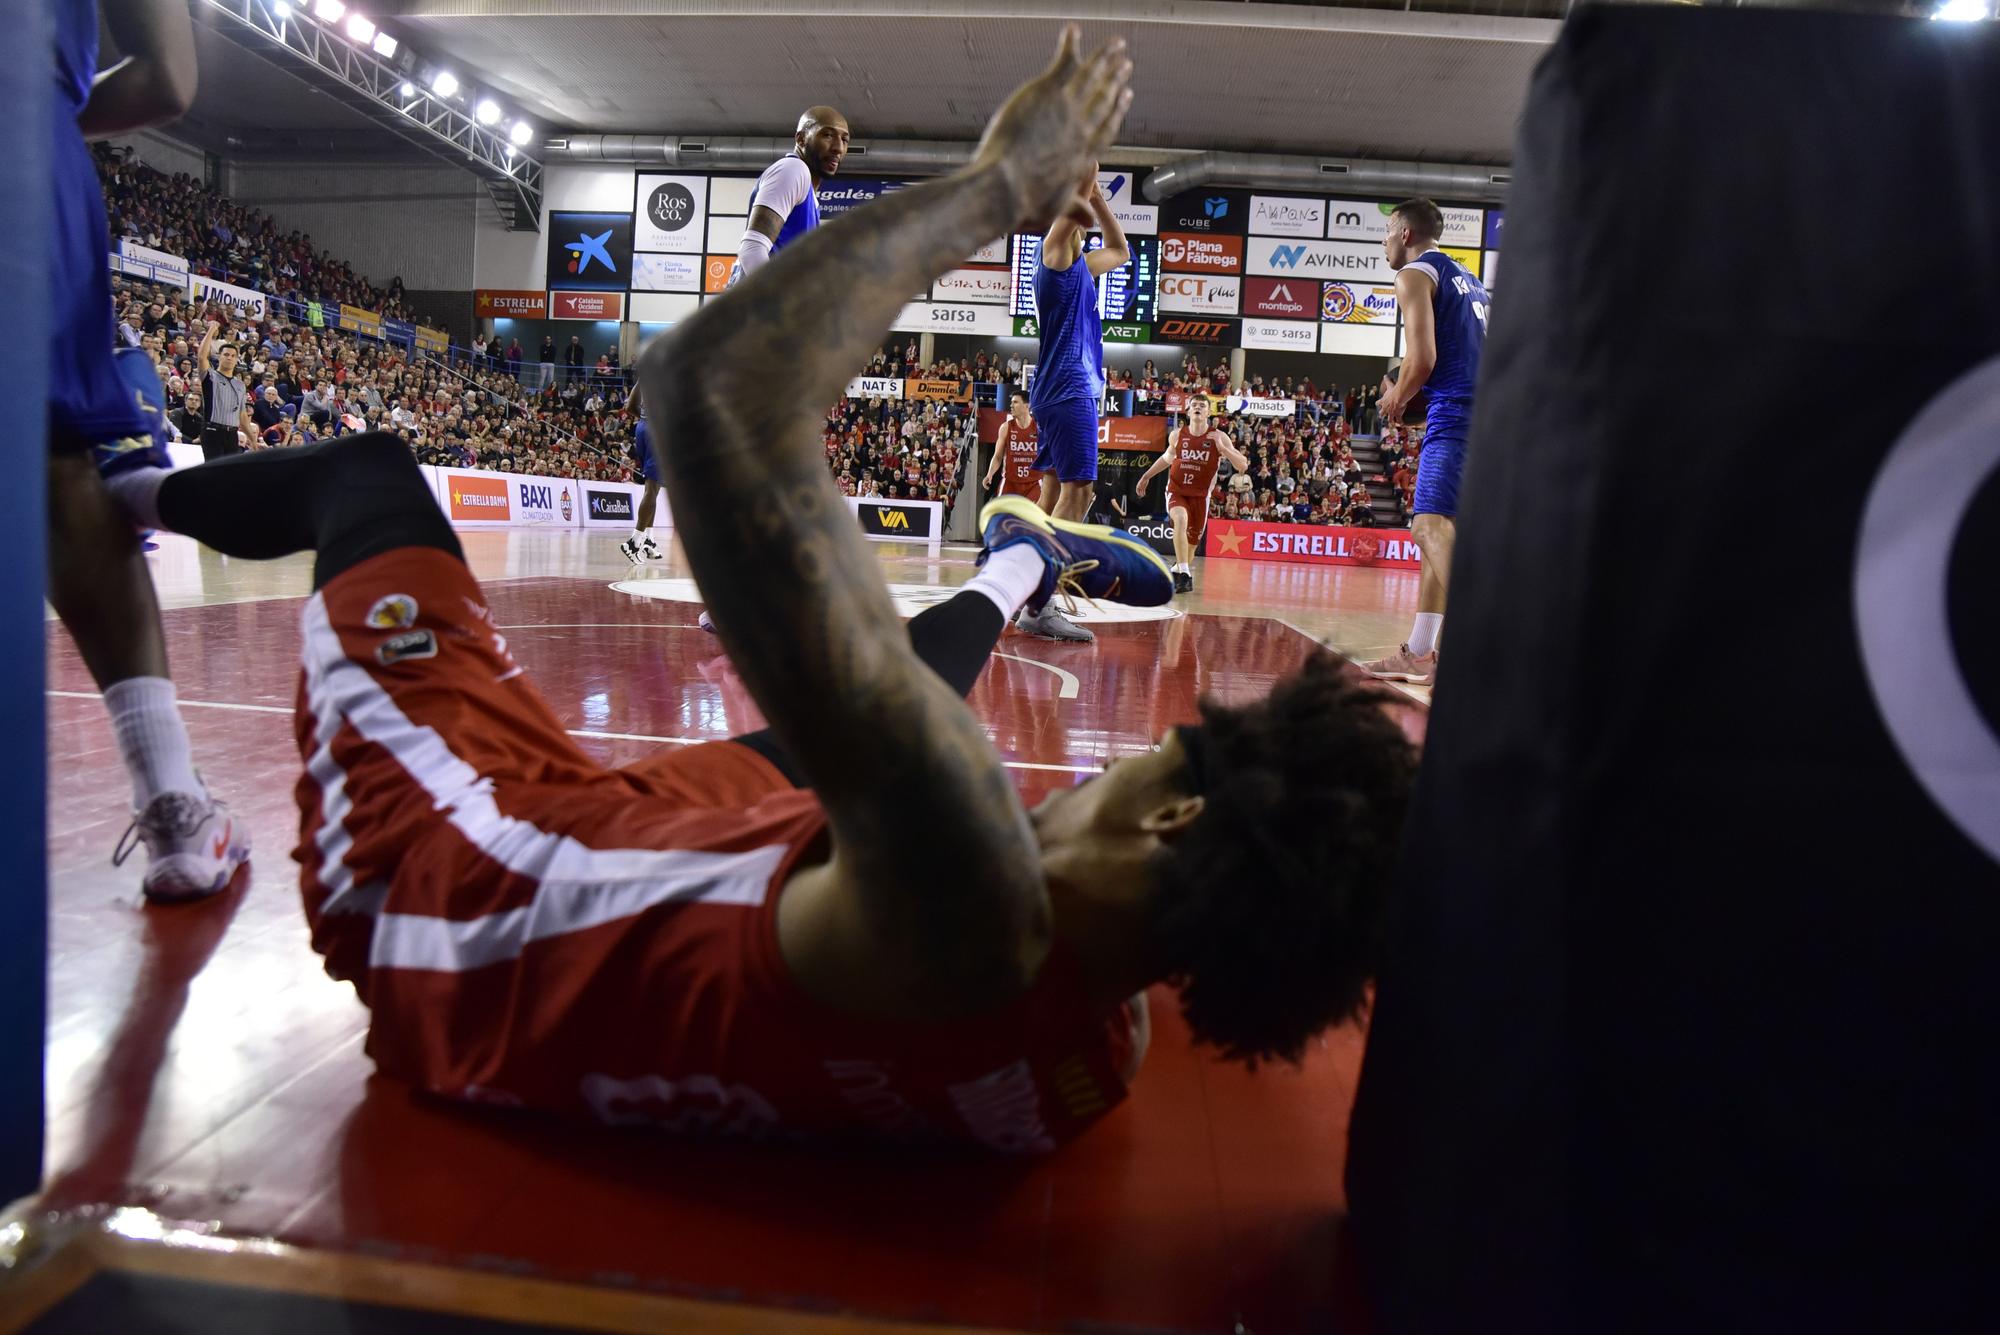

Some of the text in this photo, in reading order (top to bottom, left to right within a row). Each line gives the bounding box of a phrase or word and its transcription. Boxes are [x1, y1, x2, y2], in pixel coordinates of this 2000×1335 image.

[658, 193, 687, 210] Ros
[1179, 218, 1211, 228] CUBE
[1187, 240, 1223, 253] Plana
[1305, 254, 1380, 270] AVINENT
[1160, 277, 1207, 297] GCT
[1208, 286, 1236, 303] plus
[494, 297, 544, 309] ESTRELLA
[1259, 301, 1303, 314] montepio
[932, 308, 976, 323] sarsa
[1103, 326, 1141, 338] ARET
[1160, 320, 1230, 337] DMT
[1282, 329, 1312, 340] sarsa
[1249, 402, 1285, 411] masats
[1010, 441, 1038, 452] BAXI
[1181, 449, 1210, 462] BAXI
[1017, 466, 1030, 478] 55
[1183, 473, 1195, 485] 12
[462, 494, 508, 508] ESTRELLA DAMM
[520, 483, 553, 510] BAXI
[600, 498, 631, 514] CaixaBank
[878, 511, 909, 529] VIA
[1252, 531, 1355, 557] ESTRELL
